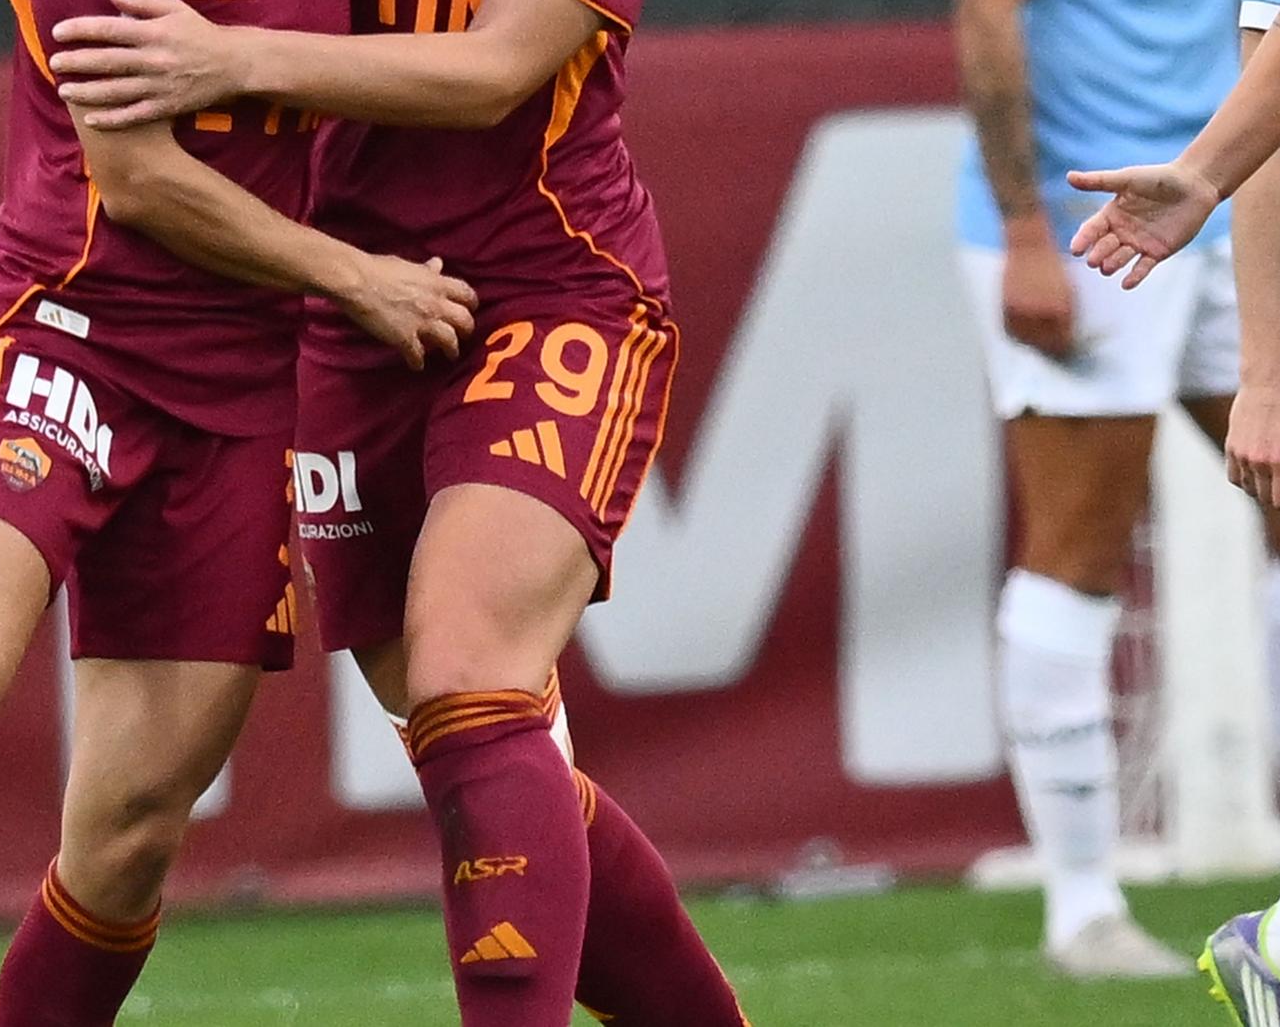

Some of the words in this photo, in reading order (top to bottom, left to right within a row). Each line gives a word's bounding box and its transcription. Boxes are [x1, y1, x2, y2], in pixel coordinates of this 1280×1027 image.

[464, 321, 608, 417] 29
[6, 352, 113, 479] HDI
[293, 451, 362, 513] DI
[454, 855, 527, 885] ASR
